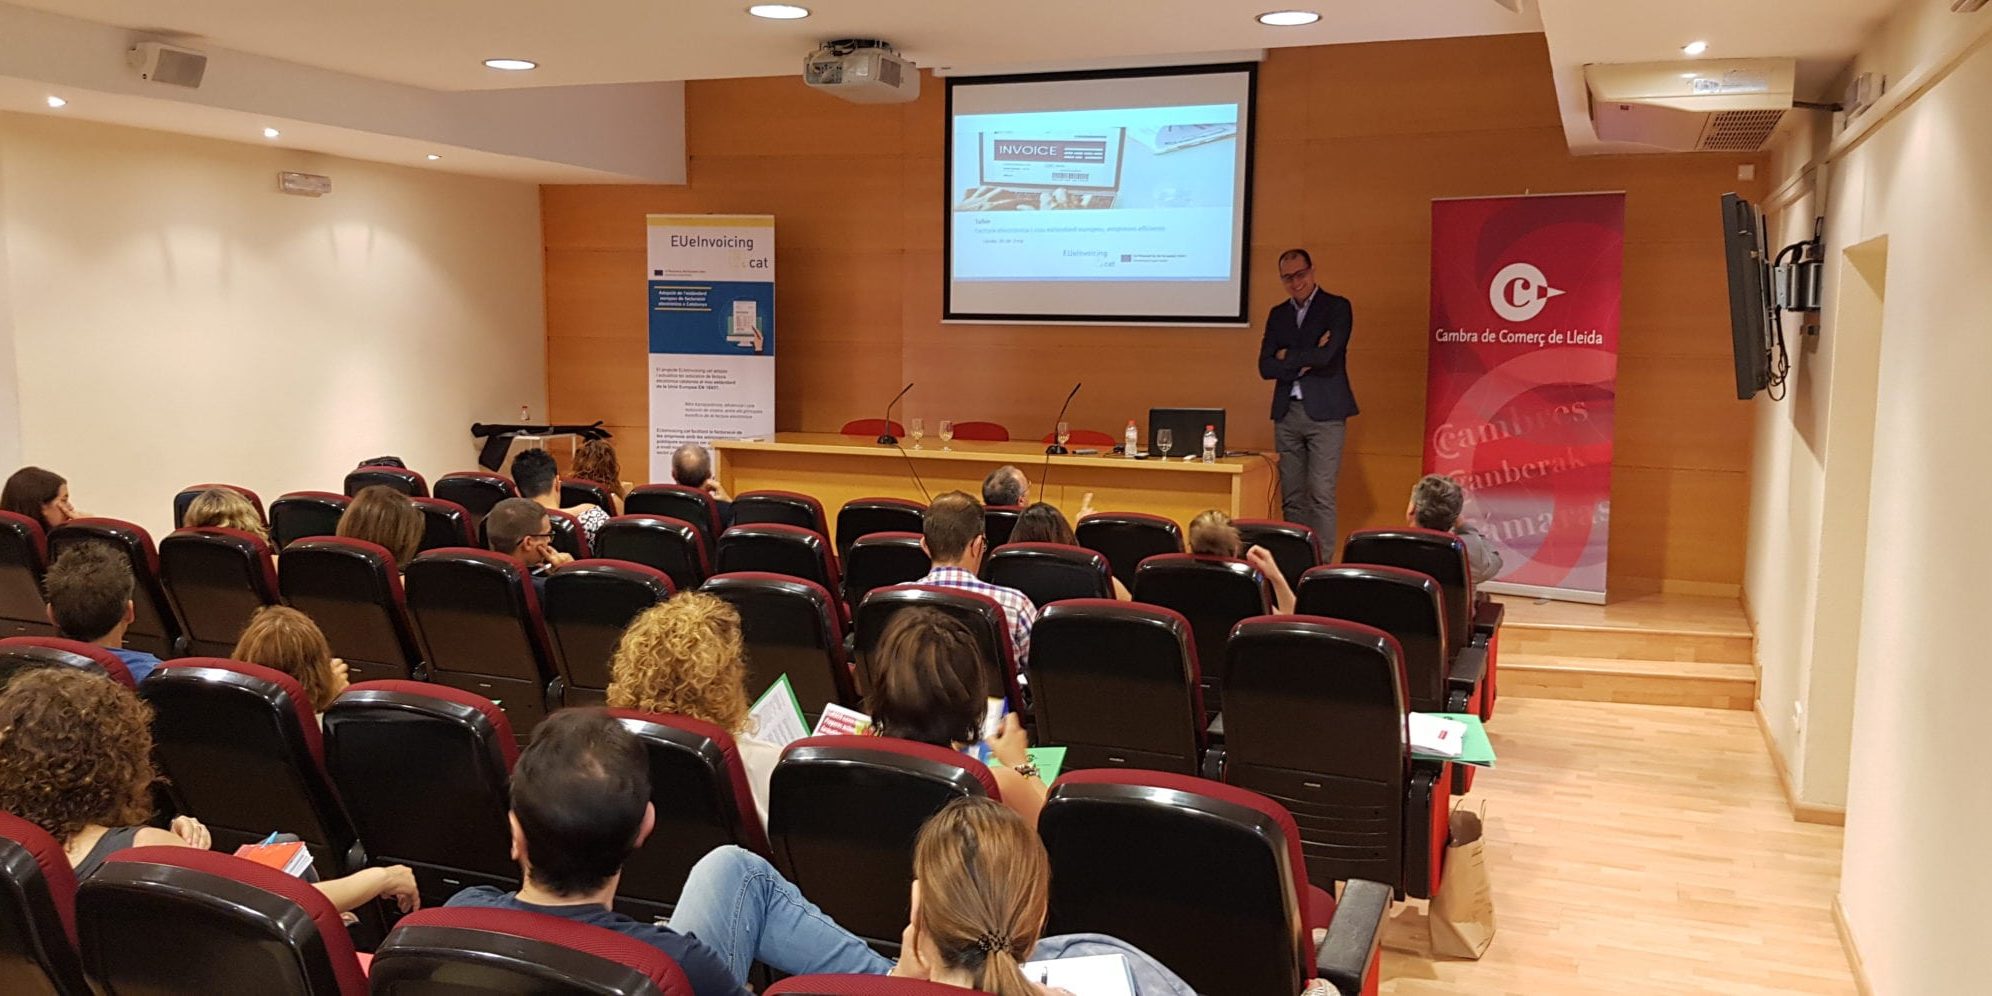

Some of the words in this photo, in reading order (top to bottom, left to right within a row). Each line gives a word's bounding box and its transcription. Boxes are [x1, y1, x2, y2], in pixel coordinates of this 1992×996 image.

[1000, 144, 1057, 156] INVOICE
[671, 235, 754, 251] EUeInvoicing
[1436, 328, 1478, 343] Cambra
[1481, 328, 1496, 342] de
[1499, 329, 1545, 347] Comerç
[1548, 330, 1563, 344] de
[1567, 330, 1603, 345] Lleida
